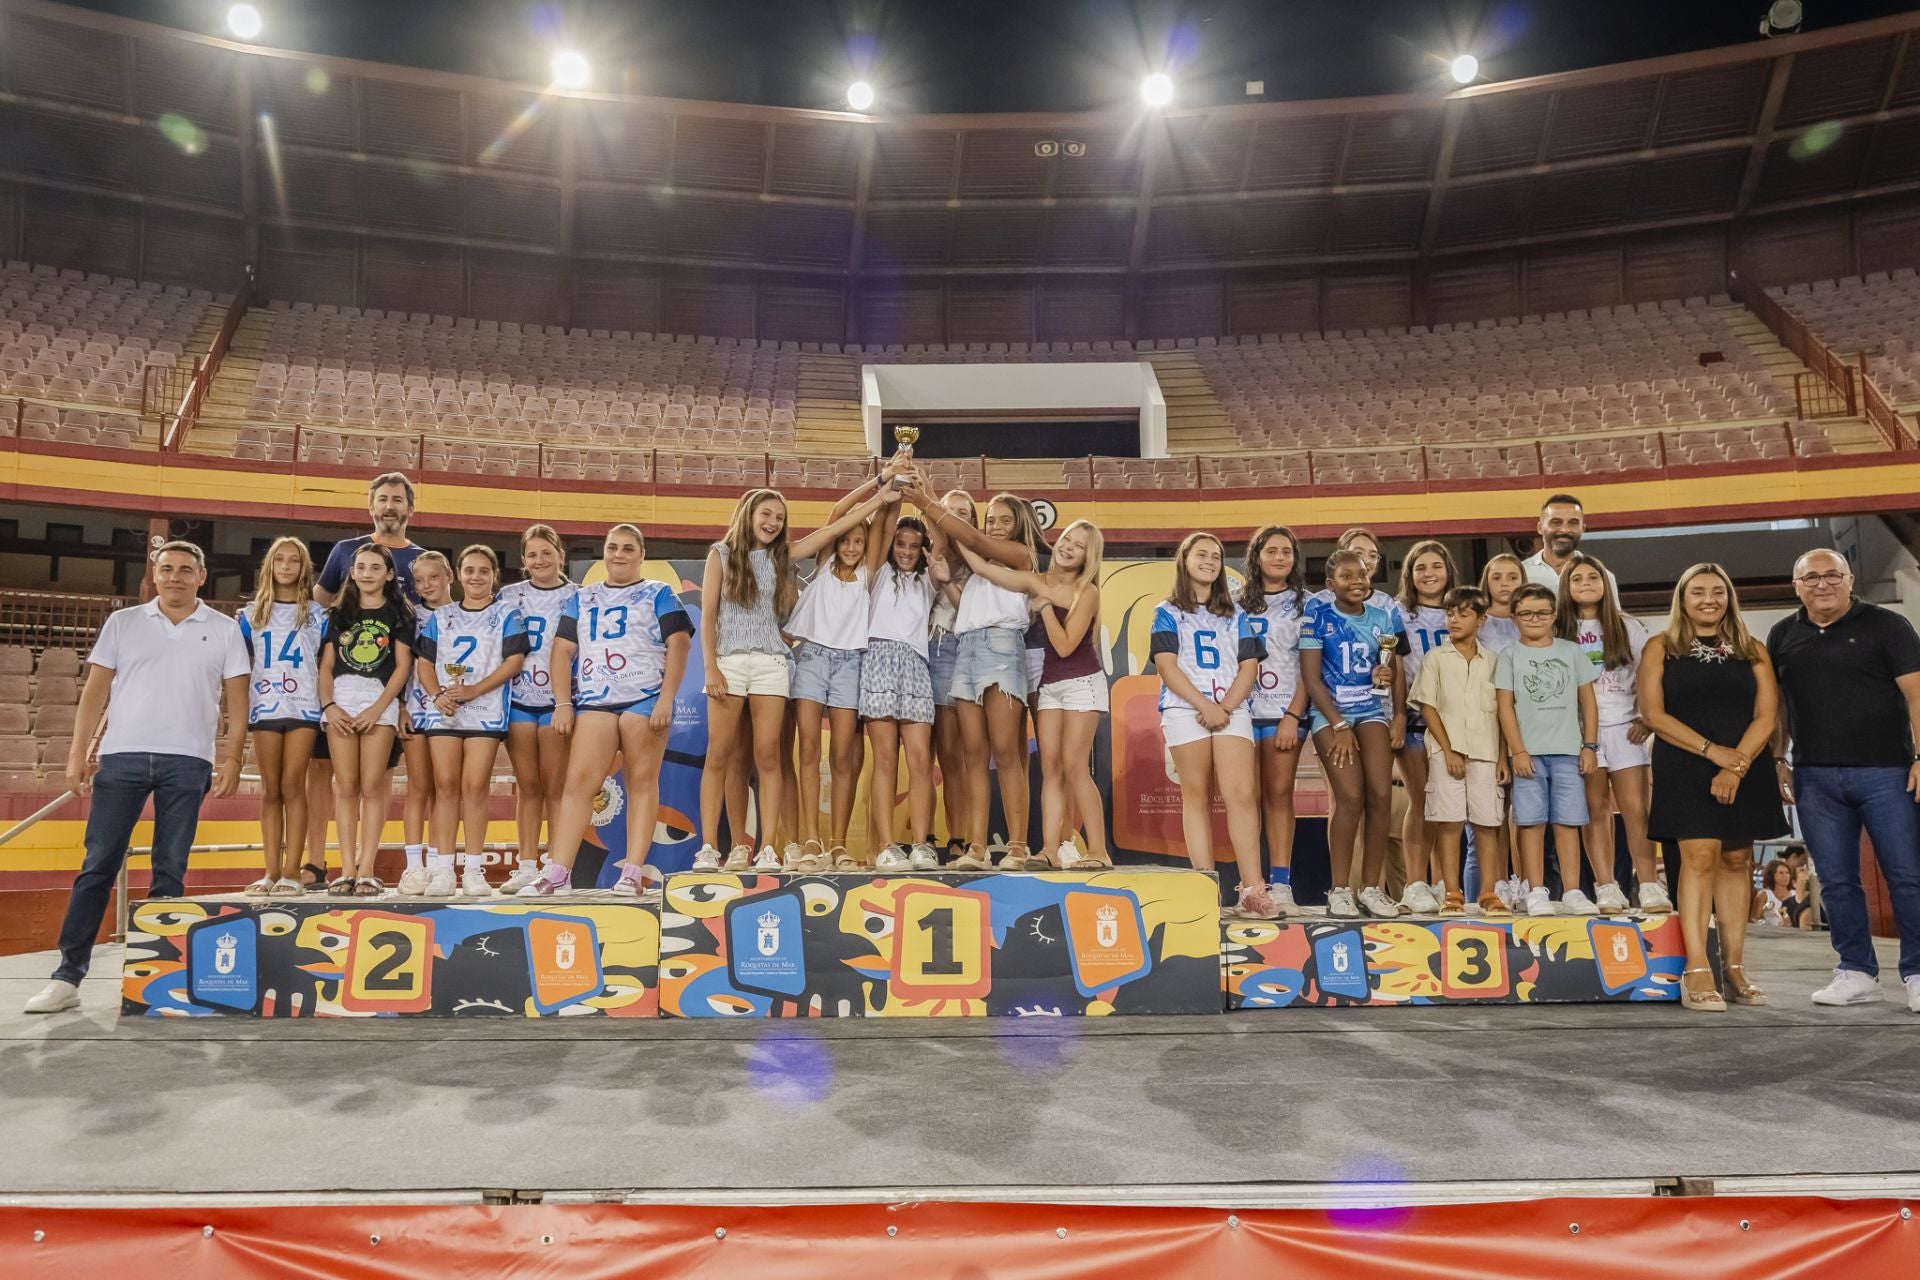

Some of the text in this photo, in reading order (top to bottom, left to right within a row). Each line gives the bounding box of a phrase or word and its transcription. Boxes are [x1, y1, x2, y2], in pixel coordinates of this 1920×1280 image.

[523, 616, 547, 652] 8
[588, 605, 628, 642] 13
[260, 630, 304, 669] 14
[453, 635, 478, 673] 2
[1193, 630, 1220, 670] 6
[1338, 641, 1372, 674] 13
[676, 705, 697, 714] MAR
[1140, 793, 1183, 804] ROQUETA
[917, 908, 963, 975] 1
[364, 931, 414, 991] 2
[1456, 937, 1491, 985] 3
